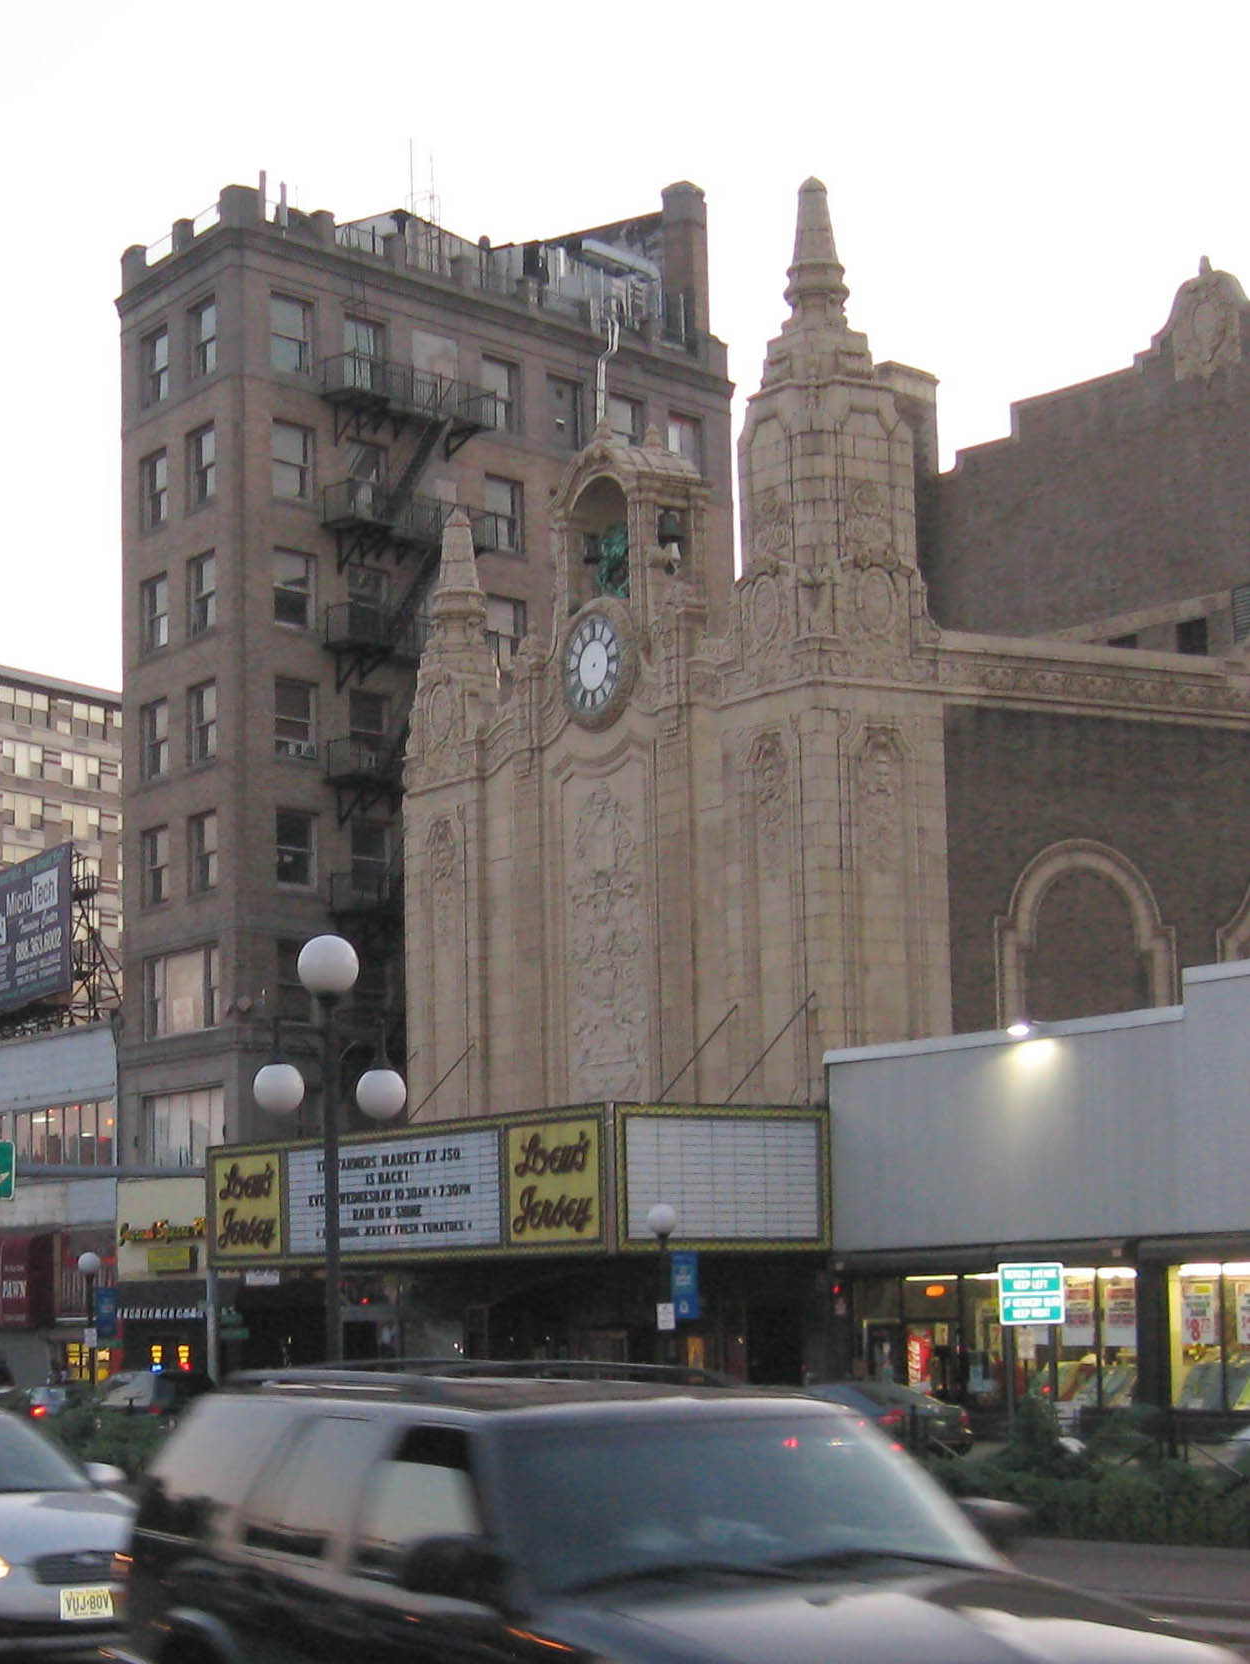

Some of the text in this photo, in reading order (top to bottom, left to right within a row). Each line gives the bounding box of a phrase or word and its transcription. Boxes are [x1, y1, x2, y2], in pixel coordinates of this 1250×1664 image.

[381, 1151, 420, 1167] MARKET
[425, 1149, 437, 1163] AT
[366, 1170, 409, 1185] IS BACK!
[352, 1207, 375, 1221] RAIN
[378, 1206, 391, 1219] OR
[512, 1185, 594, 1235] Jersey
[2, 1280, 27, 1299] PAWN
